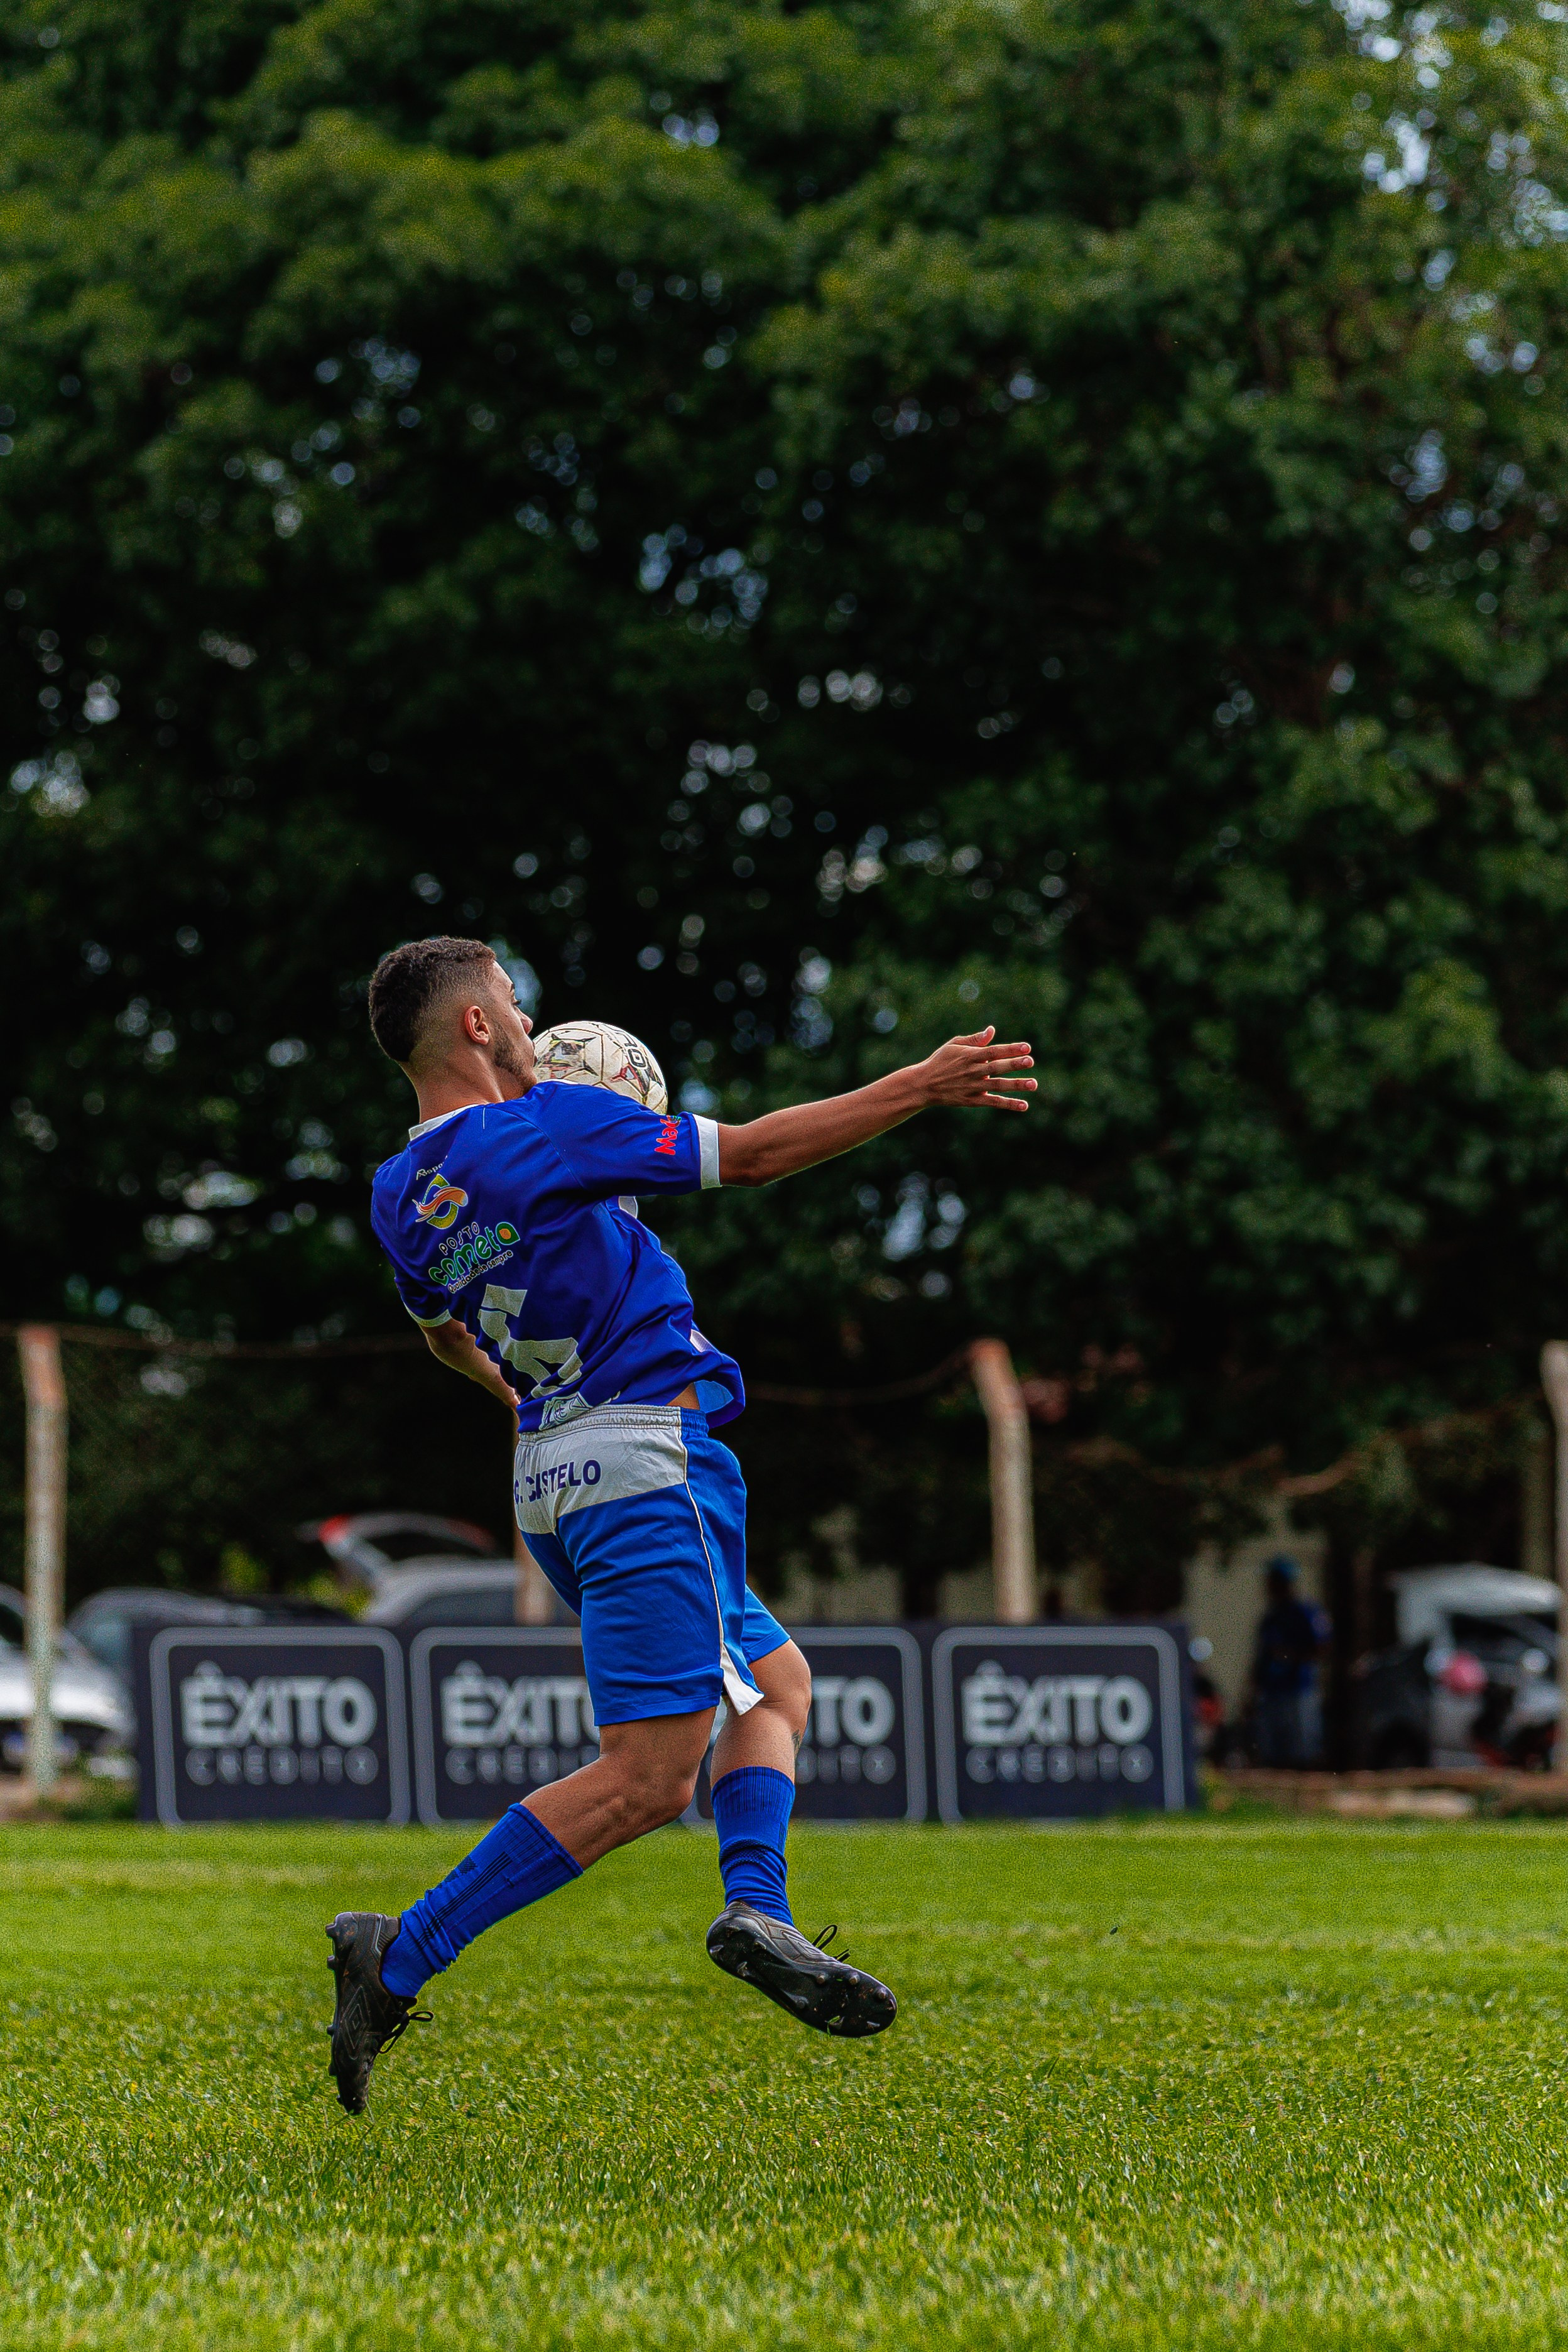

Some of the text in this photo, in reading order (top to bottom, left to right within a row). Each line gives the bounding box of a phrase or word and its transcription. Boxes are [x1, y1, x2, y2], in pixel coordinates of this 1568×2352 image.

[438, 1222, 479, 1255] POSTO
[487, 1250, 514, 1266] sempre
[526, 1459, 601, 1503] CASTELO
[180, 1660, 377, 1748] ÊXITO
[440, 1660, 599, 1748] ÊXIT
[961, 1658, 1153, 1748] ÊXITO
